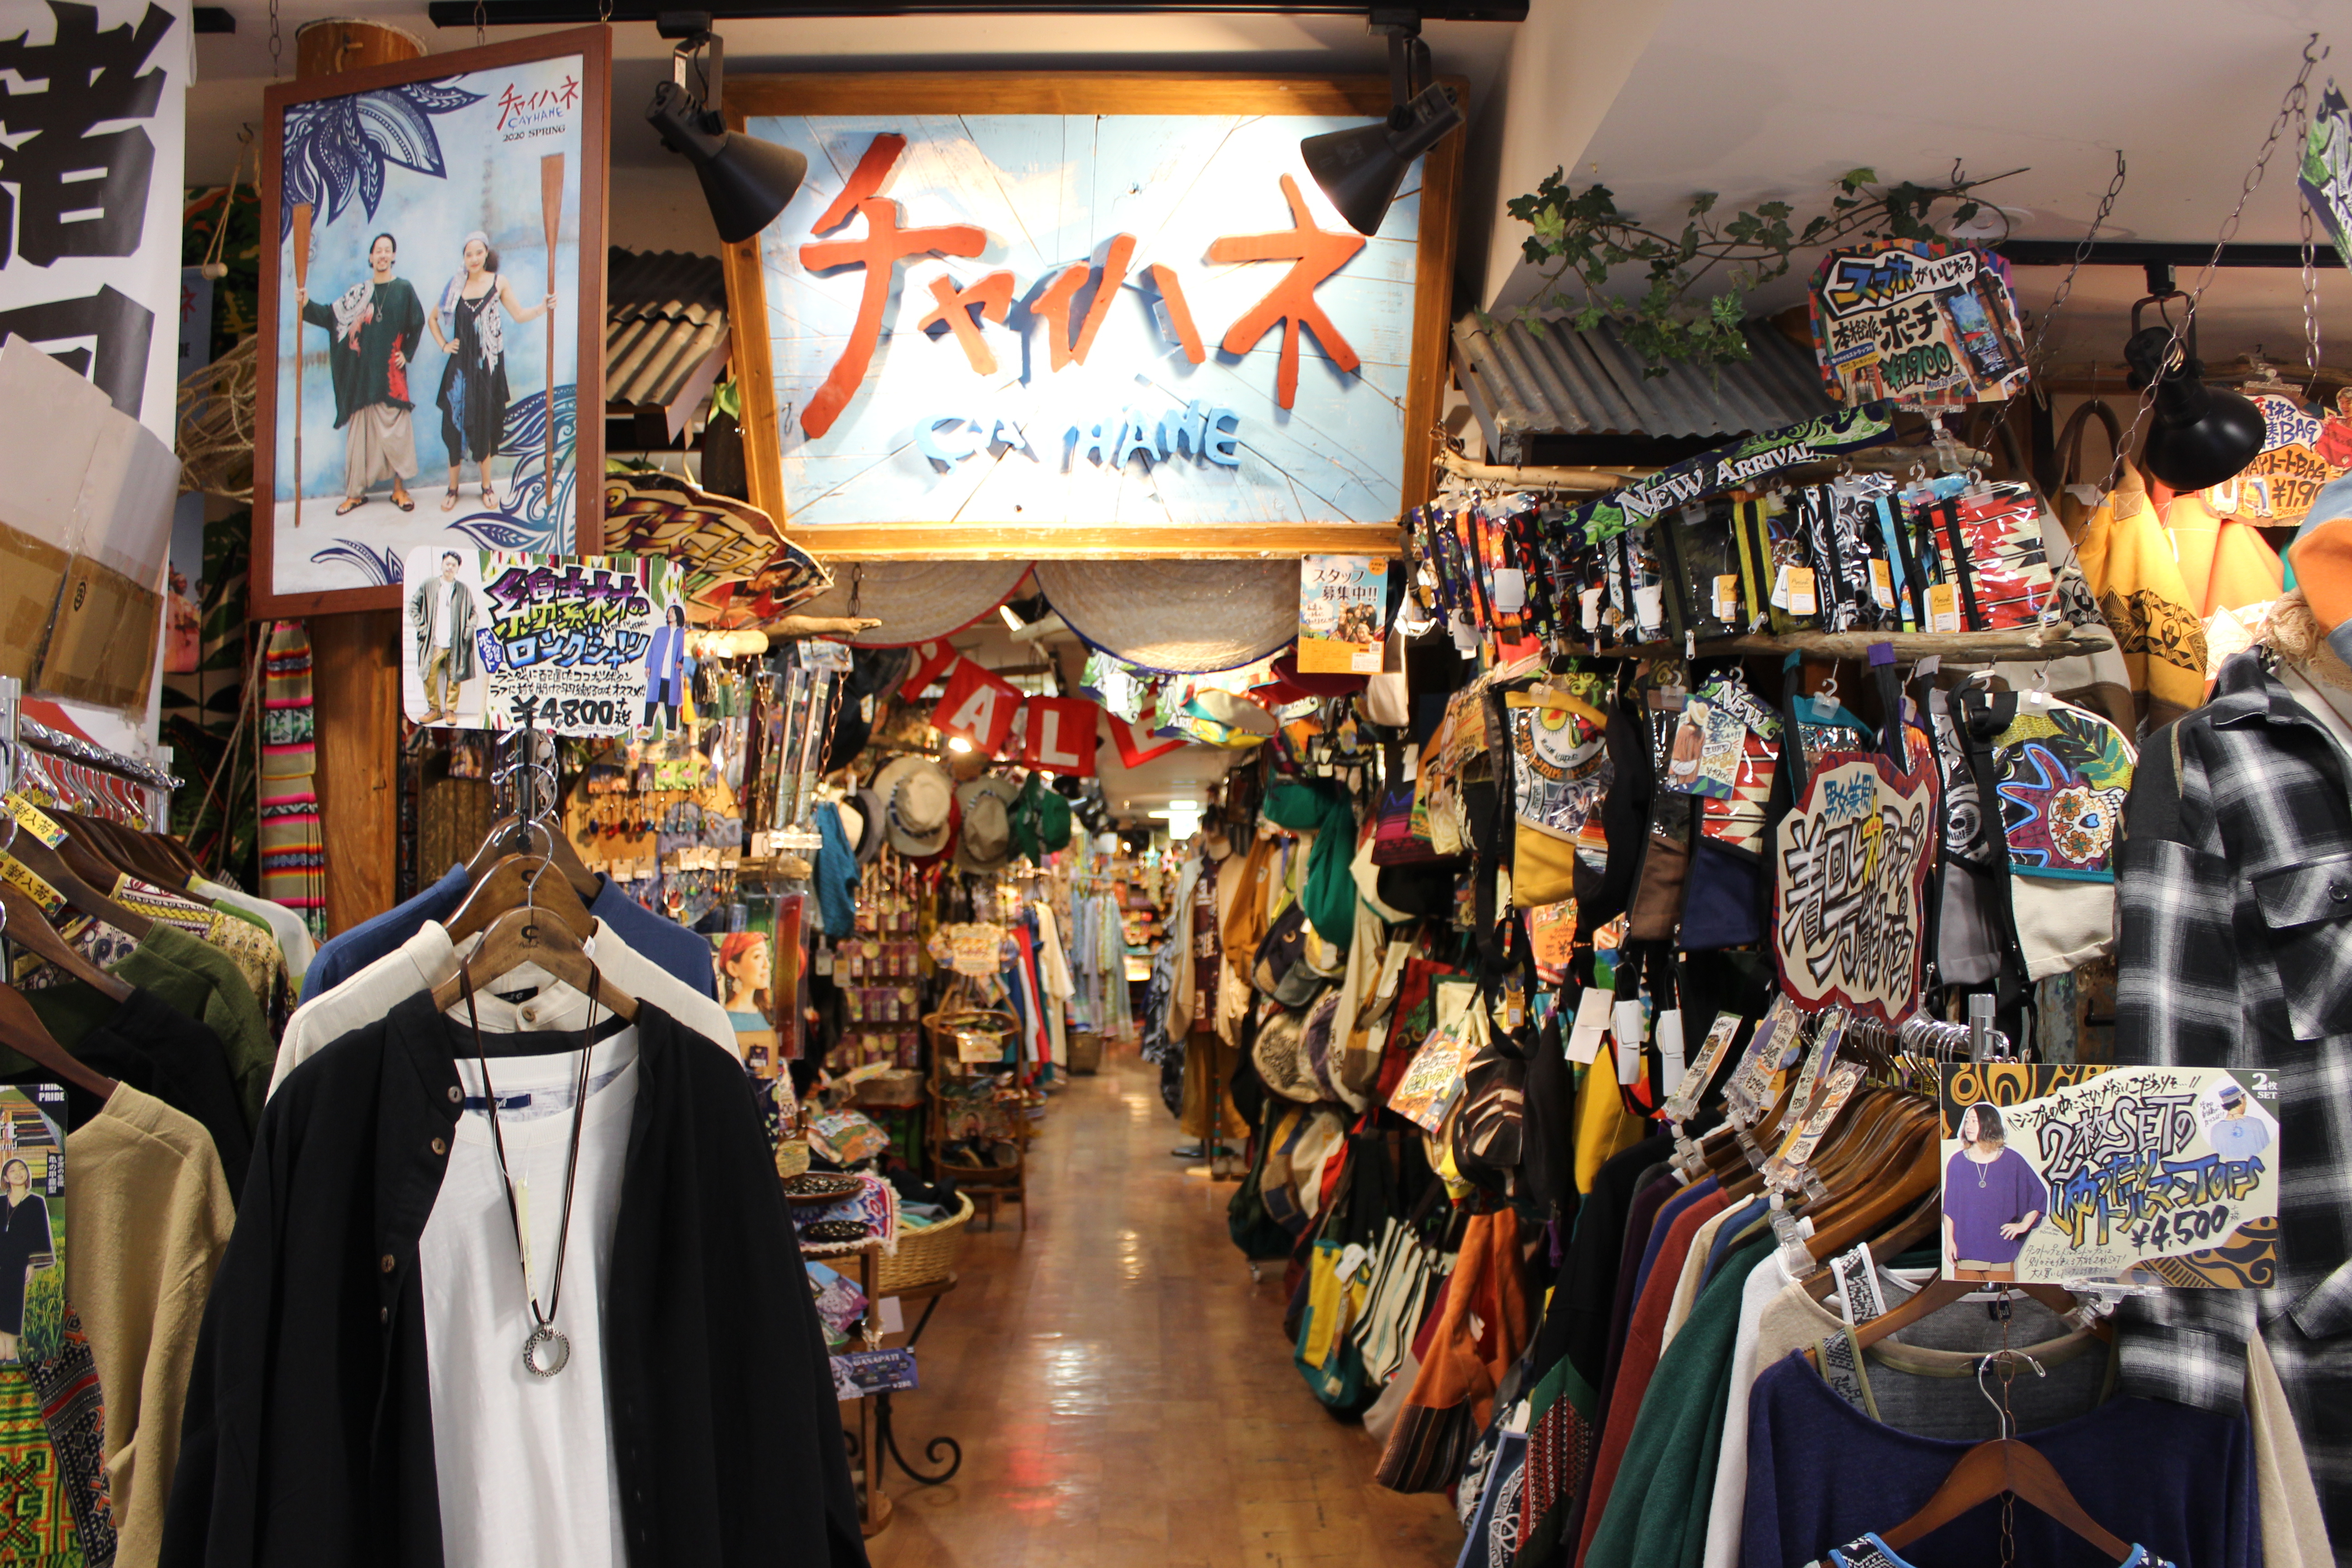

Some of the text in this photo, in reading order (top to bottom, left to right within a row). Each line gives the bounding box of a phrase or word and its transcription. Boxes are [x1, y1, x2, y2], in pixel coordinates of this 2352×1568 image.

[497, 75, 579, 132] チャイハネ
[502, 125, 566, 142] 2020 SPRING
[798, 132, 1367, 440] チャイハネ
[1832, 299, 1938, 351] 本格派ポーチ
[1313, 568, 1365, 583] スタッフ
[1321, 586, 1378, 602] 募集中!!
[485, 564, 651, 638] 綿素材の
[478, 632, 496, 671] ポケット
[503, 624, 651, 670] ロングシャツ
[13, 801, 54, 834] 新入荷
[5, 863, 51, 901] 新入荷
[39, 1092, 64, 1102] PRIDE
[2251, 1073, 2278, 1090] 2枚
[2257, 1091, 2277, 1099] SET
[2132, 1205, 2230, 1256] ¥4,500
